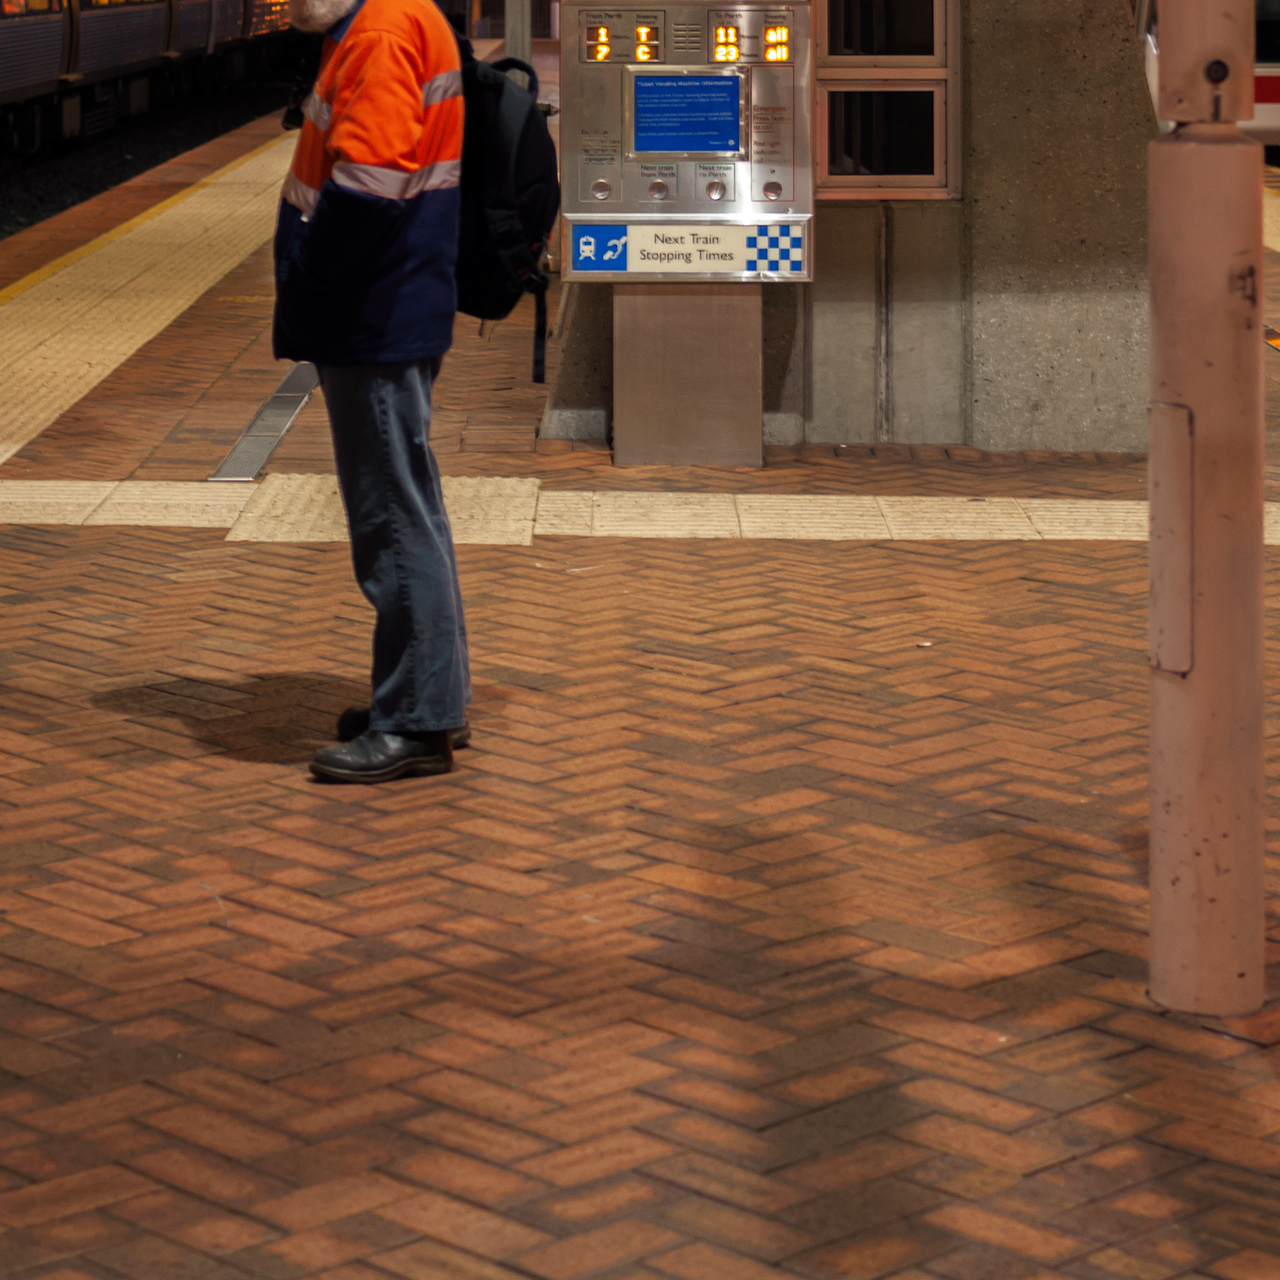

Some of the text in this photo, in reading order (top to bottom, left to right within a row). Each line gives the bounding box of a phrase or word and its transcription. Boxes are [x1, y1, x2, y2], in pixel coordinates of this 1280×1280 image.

[598, 26, 609, 43] 1
[636, 26, 651, 43] T
[716, 26, 738, 44] 11
[765, 26, 789, 44] all
[596, 44, 611, 61] 7
[636, 44, 651, 62] C
[714, 44, 740, 62] 23
[765, 44, 789, 62] all
[653, 234, 720, 245] Next Train
[639, 249, 734, 264] Stopping Times
